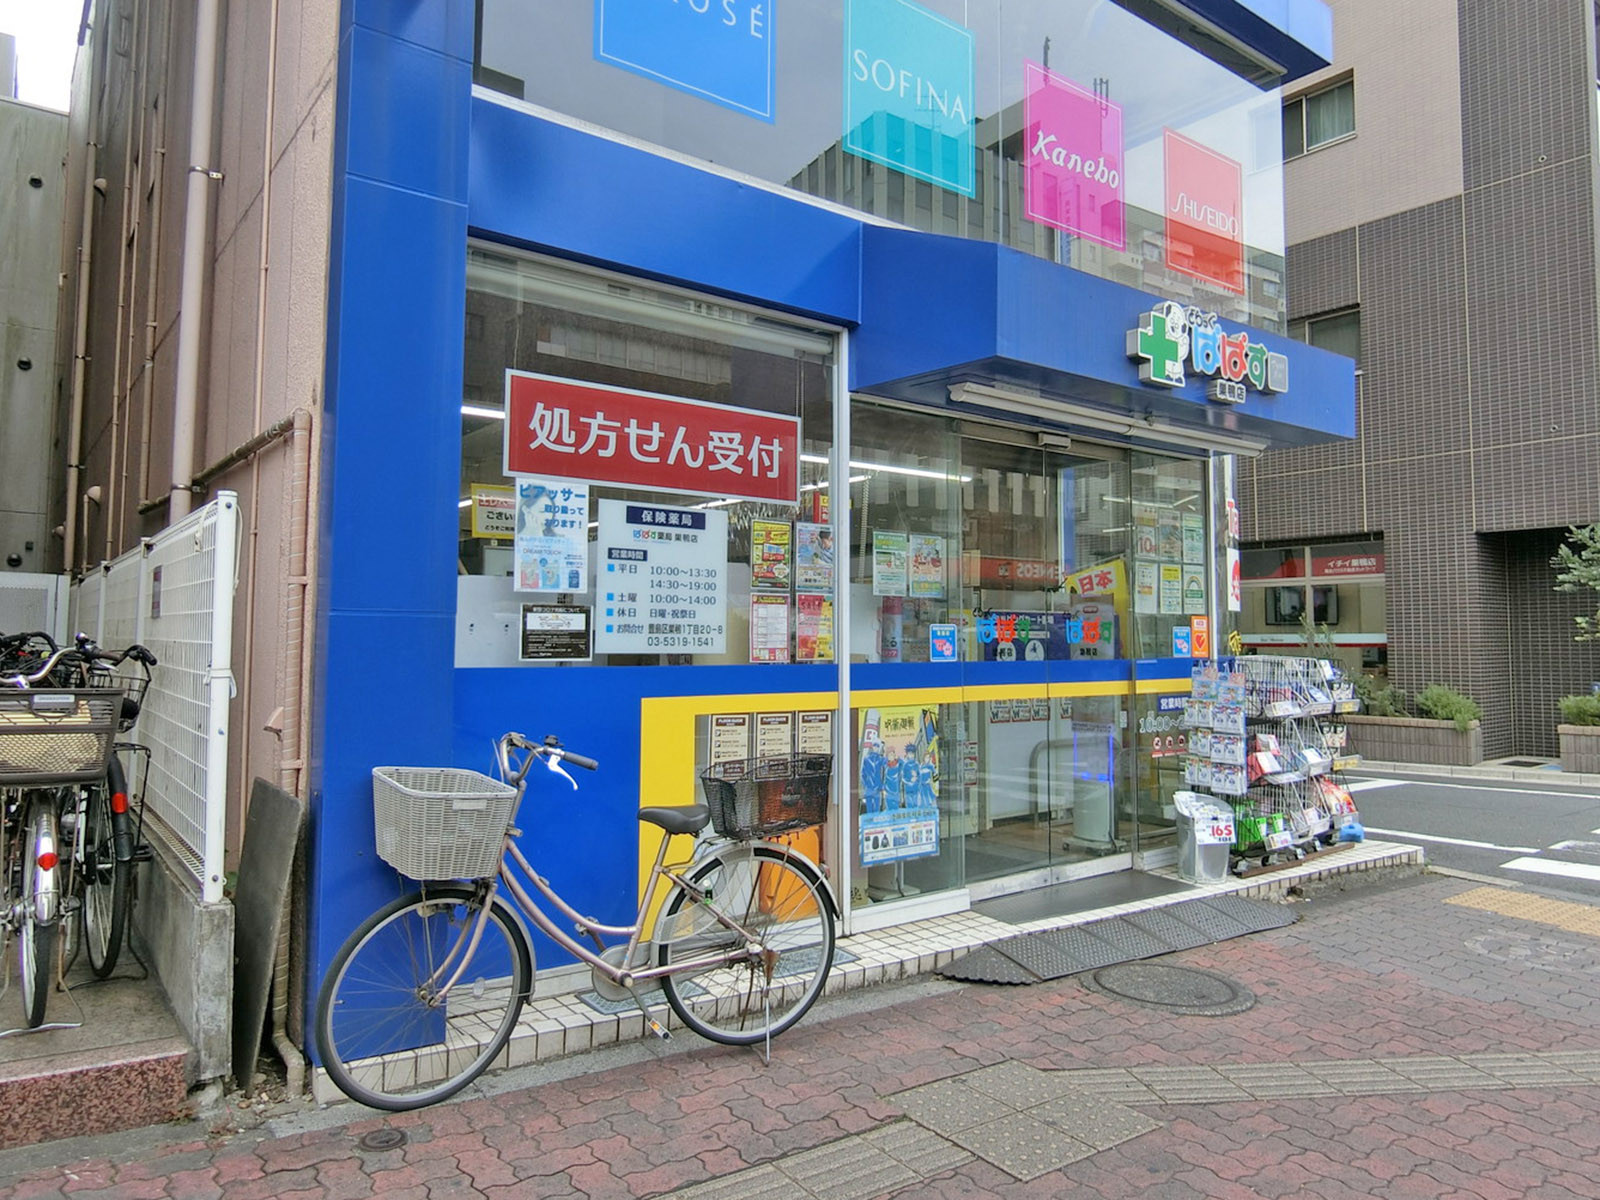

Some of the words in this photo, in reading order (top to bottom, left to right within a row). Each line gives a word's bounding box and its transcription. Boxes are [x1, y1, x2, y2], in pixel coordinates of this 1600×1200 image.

[674, 0, 763, 39] OSÉ
[853, 49, 967, 124] SOFINA
[1032, 130, 1119, 189] Kanebo
[1171, 193, 1238, 236] SHISEIDO
[528, 402, 783, 478] 処方せん受付
[520, 484, 586, 501] ピアッサー
[641, 510, 692, 526] 保険薬局
[611, 550, 644, 560] 営業時間
[618, 564, 638, 574] 平日
[650, 566, 717, 578] 10:00〜13:30
[650, 579, 717, 591] 14:30〜19:00
[1078, 570, 1113, 594] 日本
[617, 592, 638, 603] 土曜
[650, 594, 716, 605] 10:00〜14:00
[617, 608, 637, 617] 休日
[647, 636, 715, 647] 03-5319-1541
[1211, 825, 1233, 837] 165
